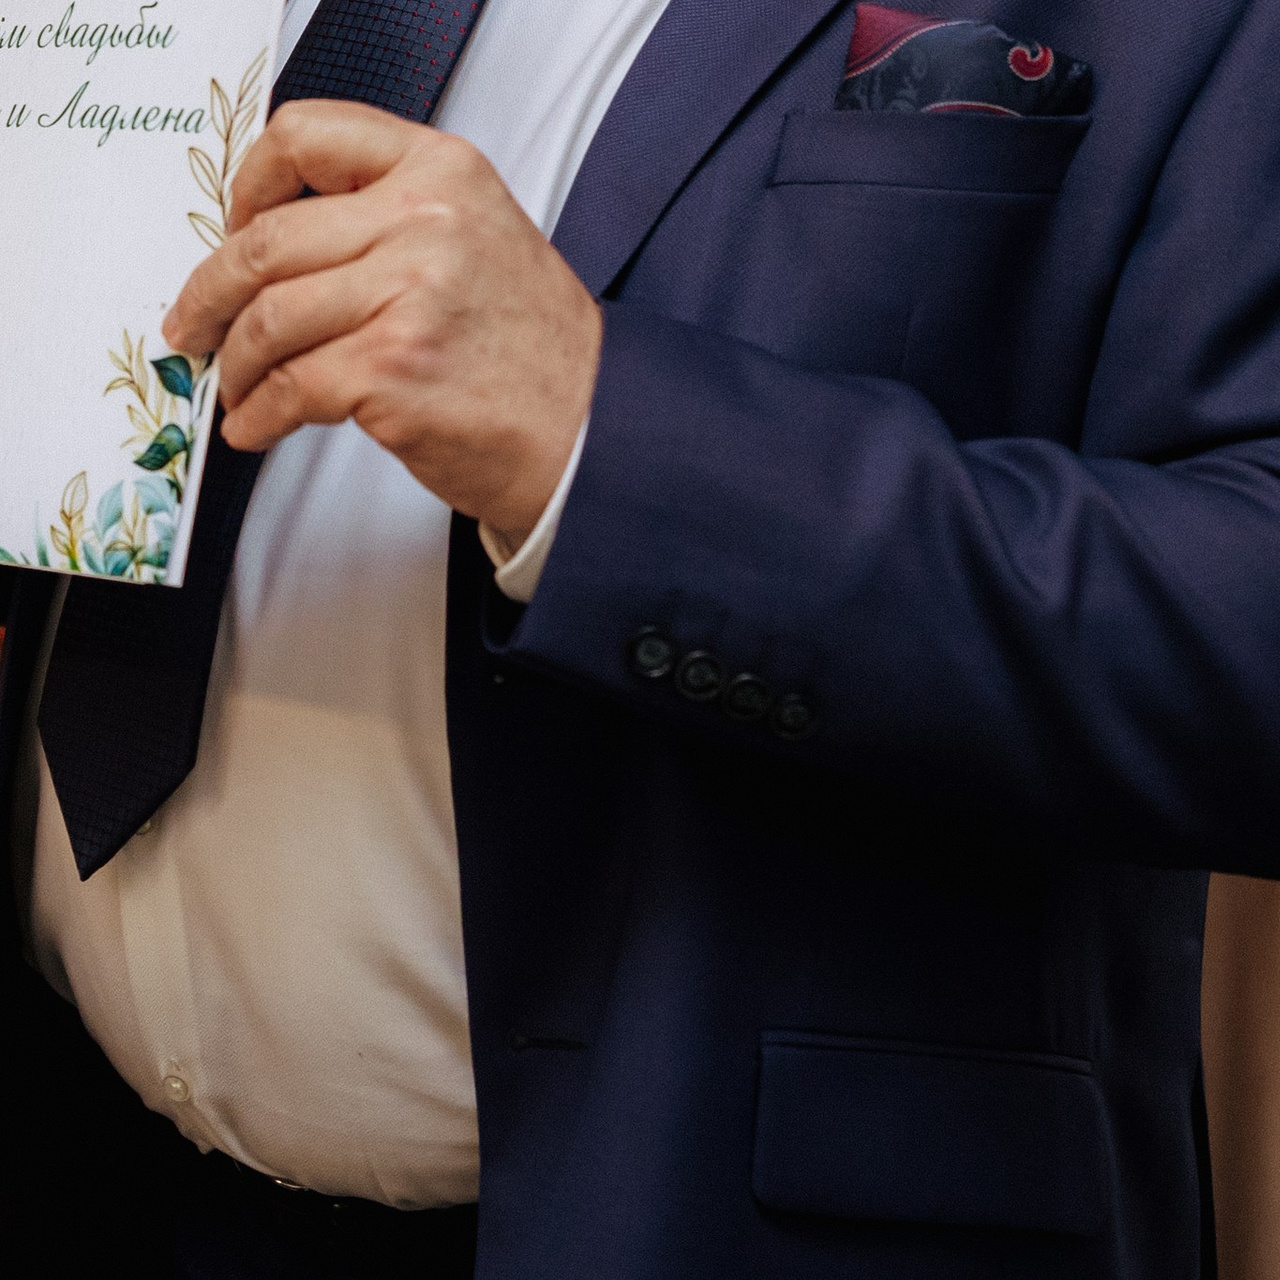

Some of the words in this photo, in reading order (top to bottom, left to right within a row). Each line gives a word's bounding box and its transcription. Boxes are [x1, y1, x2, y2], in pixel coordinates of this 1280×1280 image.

[37, 1, 179, 66] свадьбы
[6, 103, 32, 128] и
[37, 80, 208, 148] Ладлена
